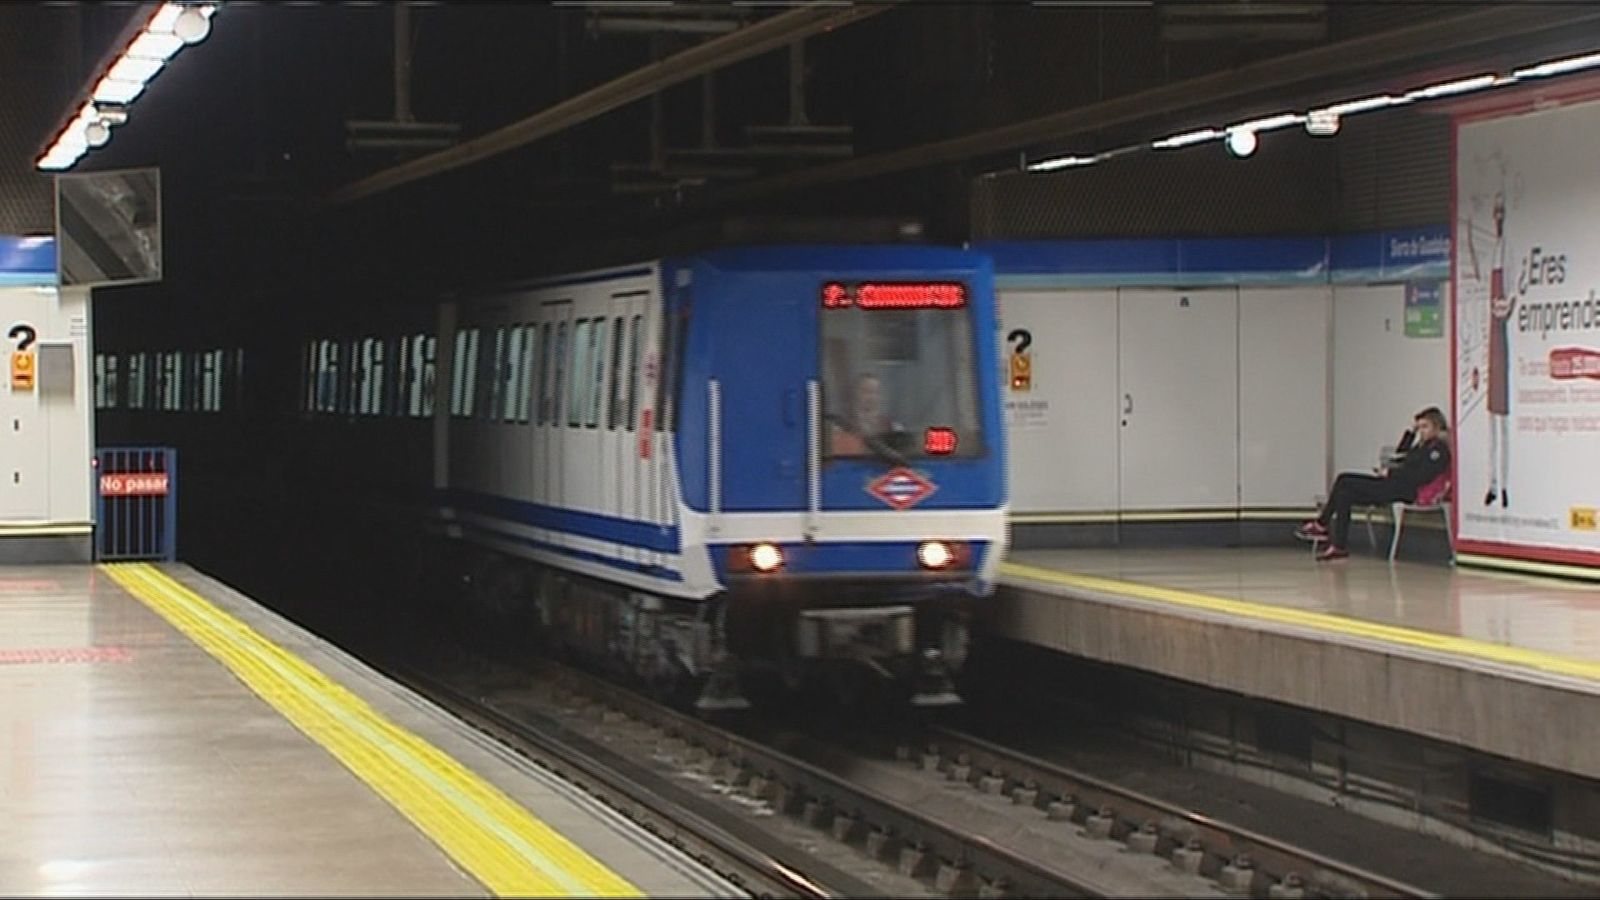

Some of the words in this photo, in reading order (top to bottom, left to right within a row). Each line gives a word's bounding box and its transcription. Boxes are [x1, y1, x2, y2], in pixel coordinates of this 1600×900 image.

[1518, 247, 1566, 295] ¿Eres
[100, 475, 122, 491] No
[126, 478, 168, 494] pasar
